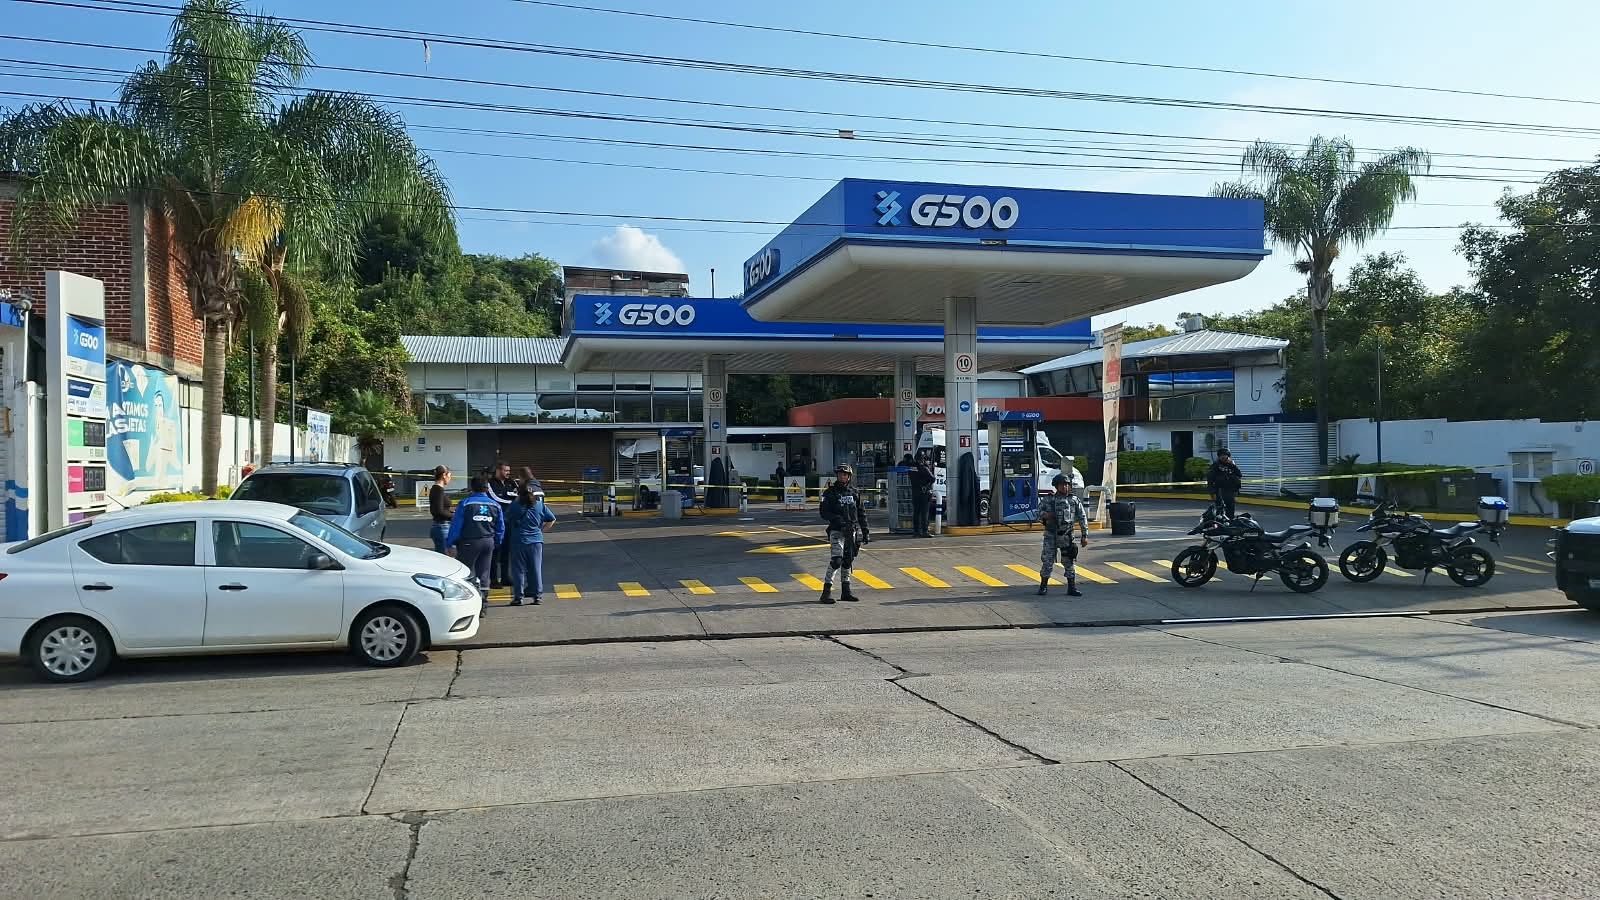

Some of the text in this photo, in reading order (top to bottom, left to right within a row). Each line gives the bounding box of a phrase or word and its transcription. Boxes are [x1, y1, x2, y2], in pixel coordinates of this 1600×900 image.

[911, 194, 1019, 229] G500
[750, 248, 771, 287] G500
[619, 303, 695, 326] G500
[80, 332, 99, 350] G500
[960, 358, 969, 366] 10
[711, 391, 720, 399] 10
[1581, 462, 1590, 472] 10
